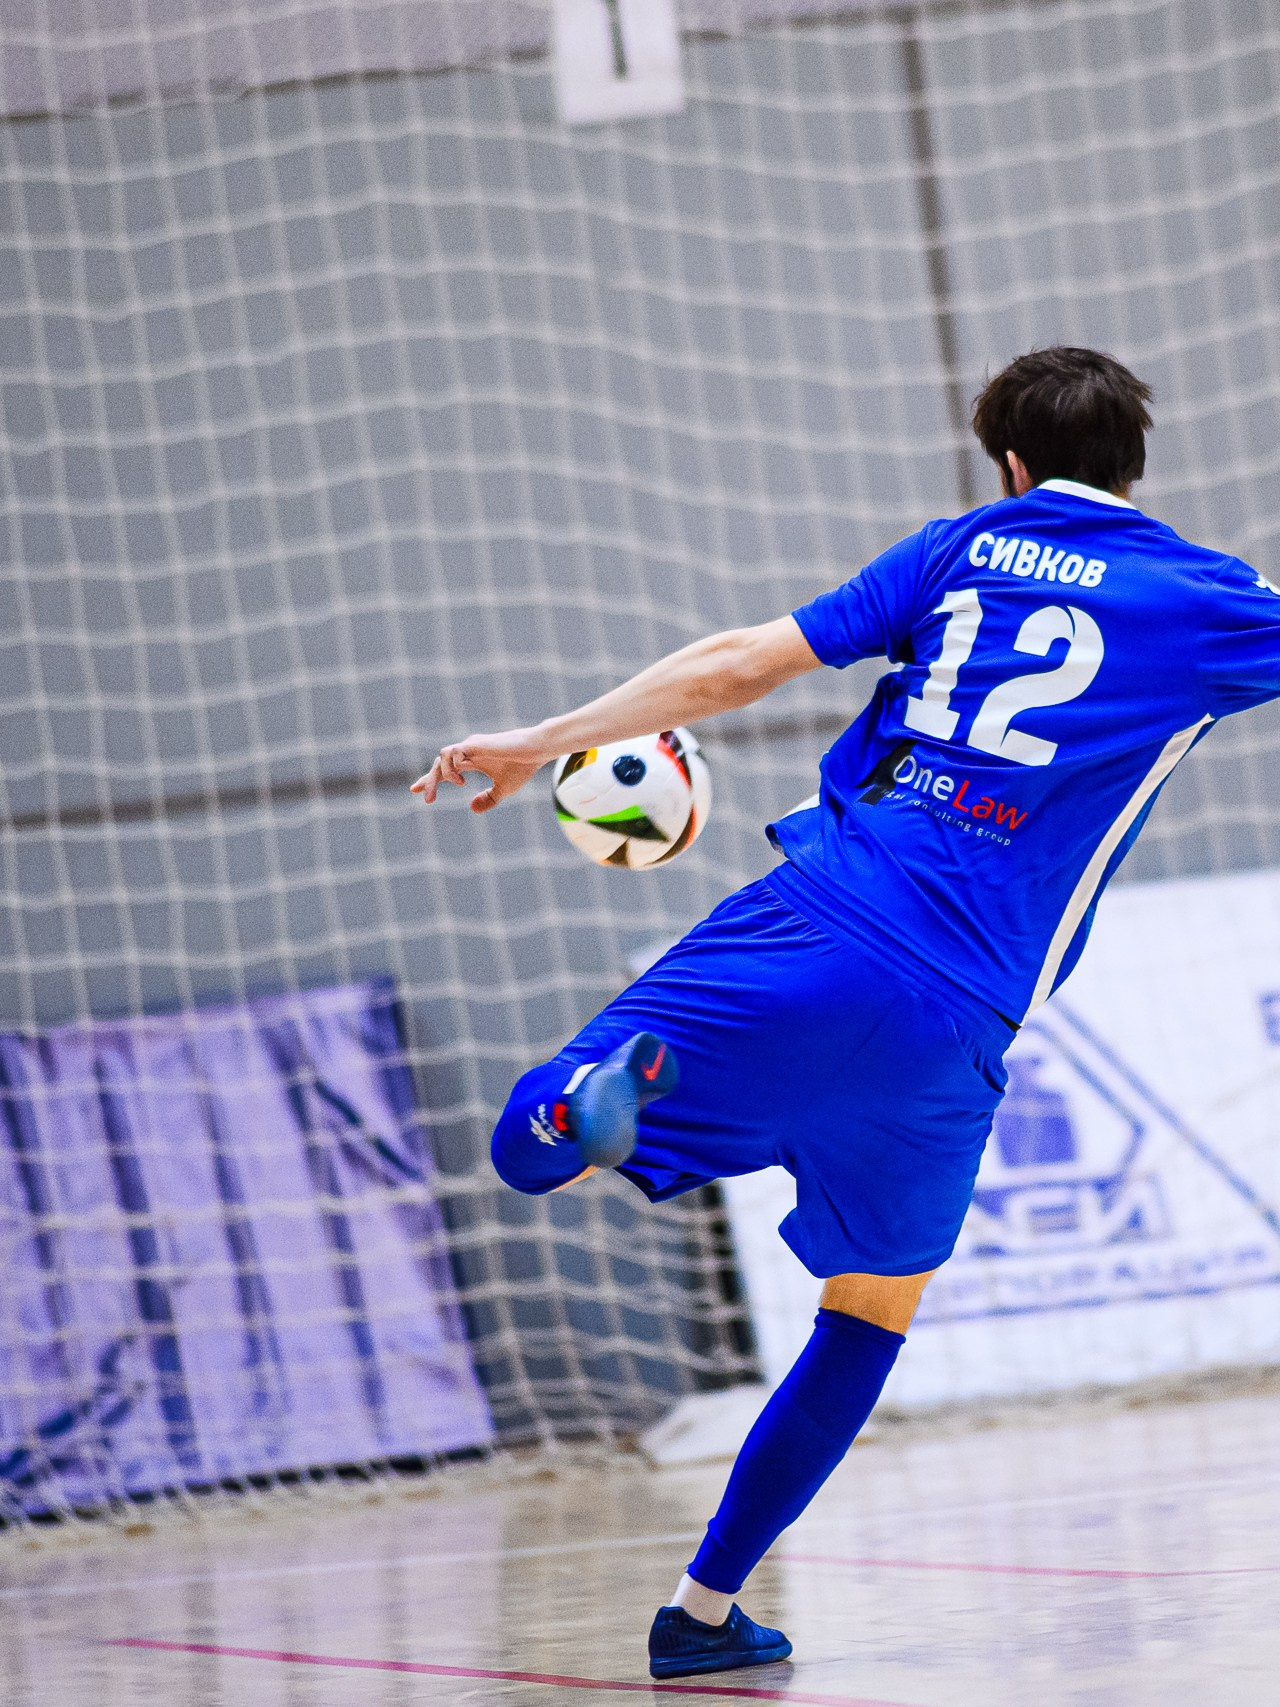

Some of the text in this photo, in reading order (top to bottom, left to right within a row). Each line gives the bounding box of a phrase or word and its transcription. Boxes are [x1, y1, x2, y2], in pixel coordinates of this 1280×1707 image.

[968, 532, 1107, 589] СИВКОВ
[903, 588, 1105, 766] 12
[893, 755, 1028, 830] OneLaw
[976, 827, 1012, 846] group
